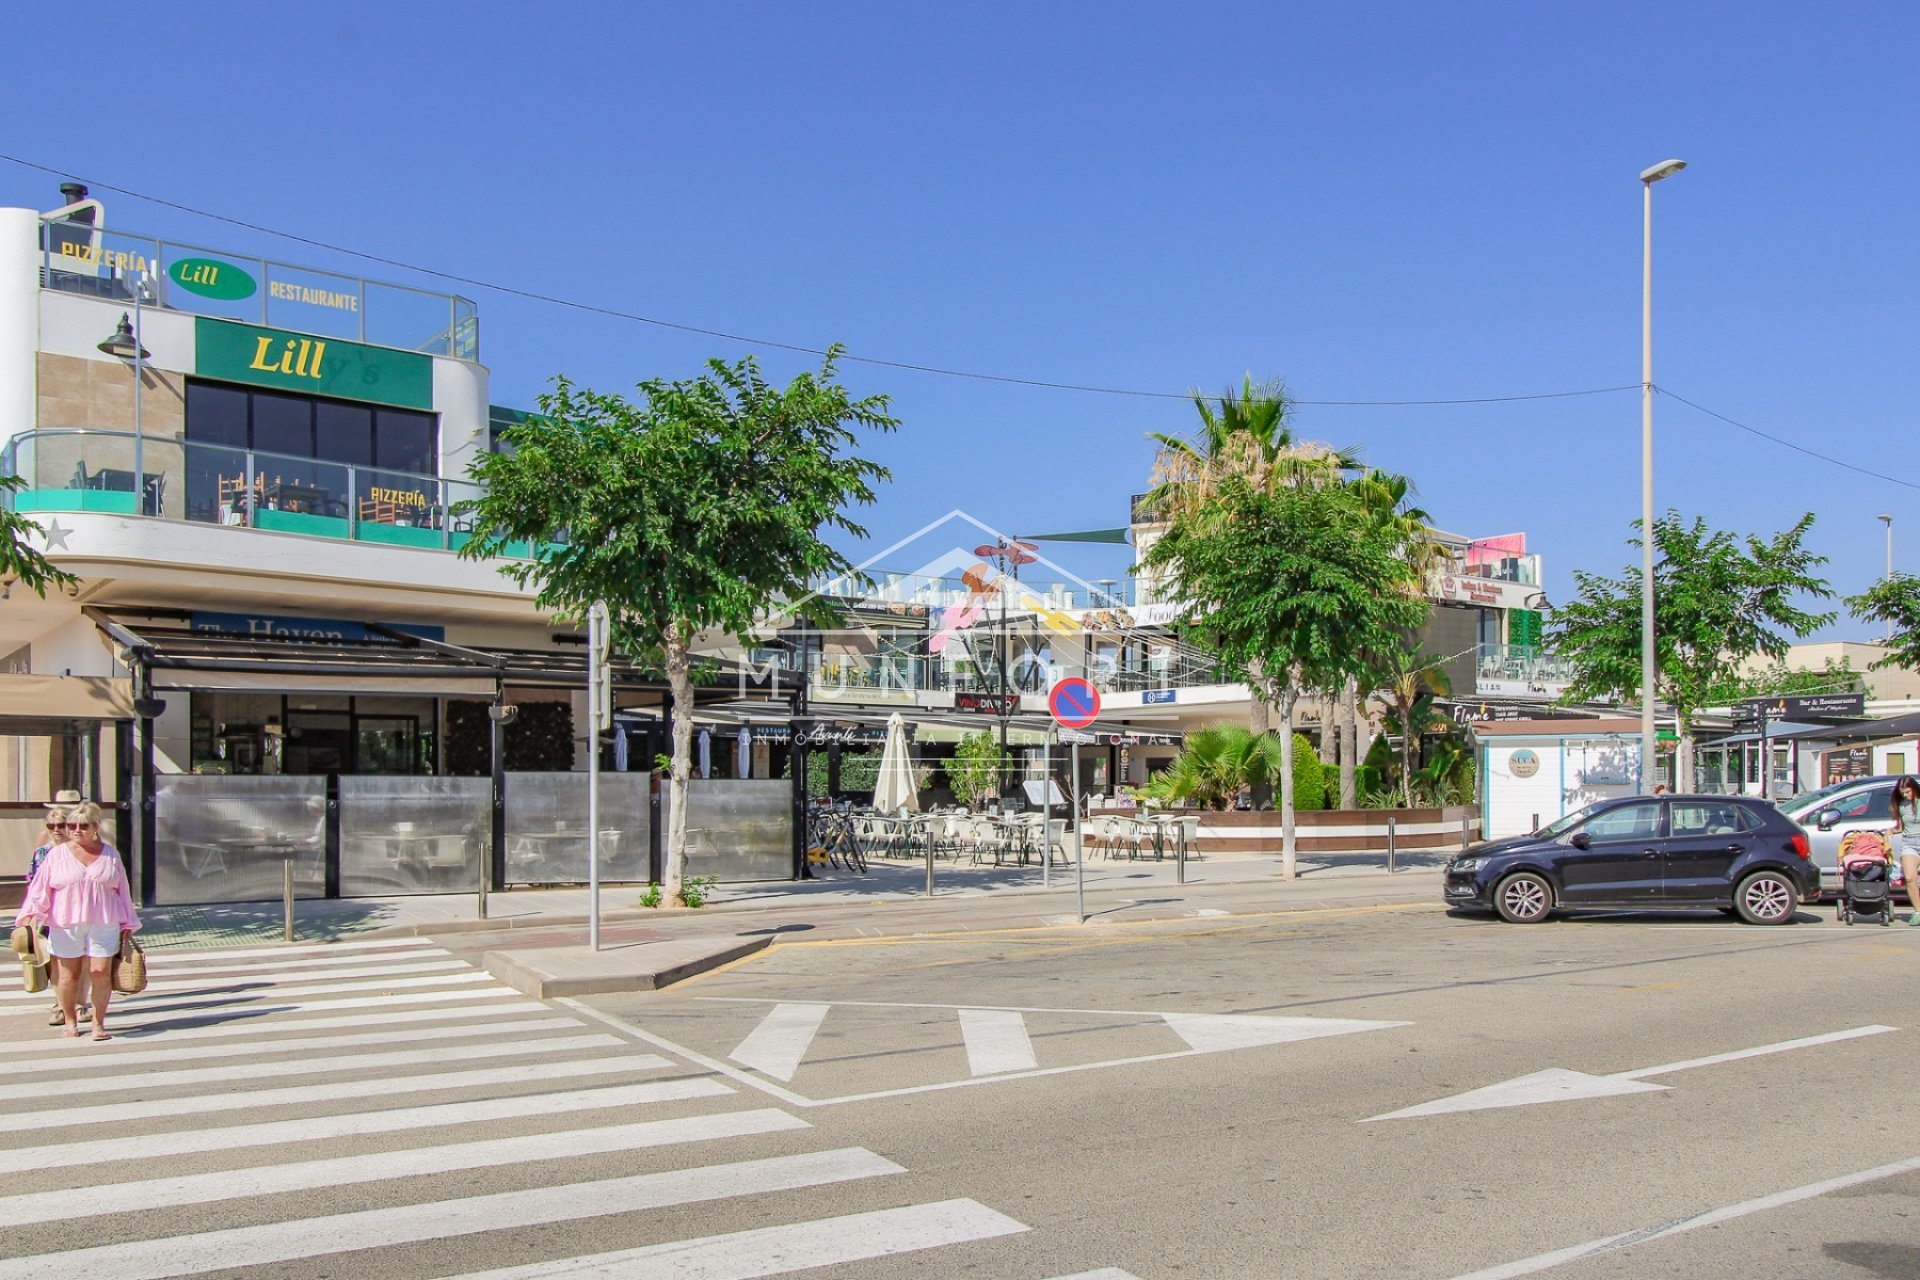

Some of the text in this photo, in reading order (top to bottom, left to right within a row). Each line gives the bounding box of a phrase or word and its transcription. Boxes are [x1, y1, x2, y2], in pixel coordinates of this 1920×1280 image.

[61, 241, 148, 272] PIZZERÍA
[269, 280, 358, 313] RESTAURANTE
[371, 486, 426, 508] PIZZERÍA
[1453, 705, 1490, 722] Flame
